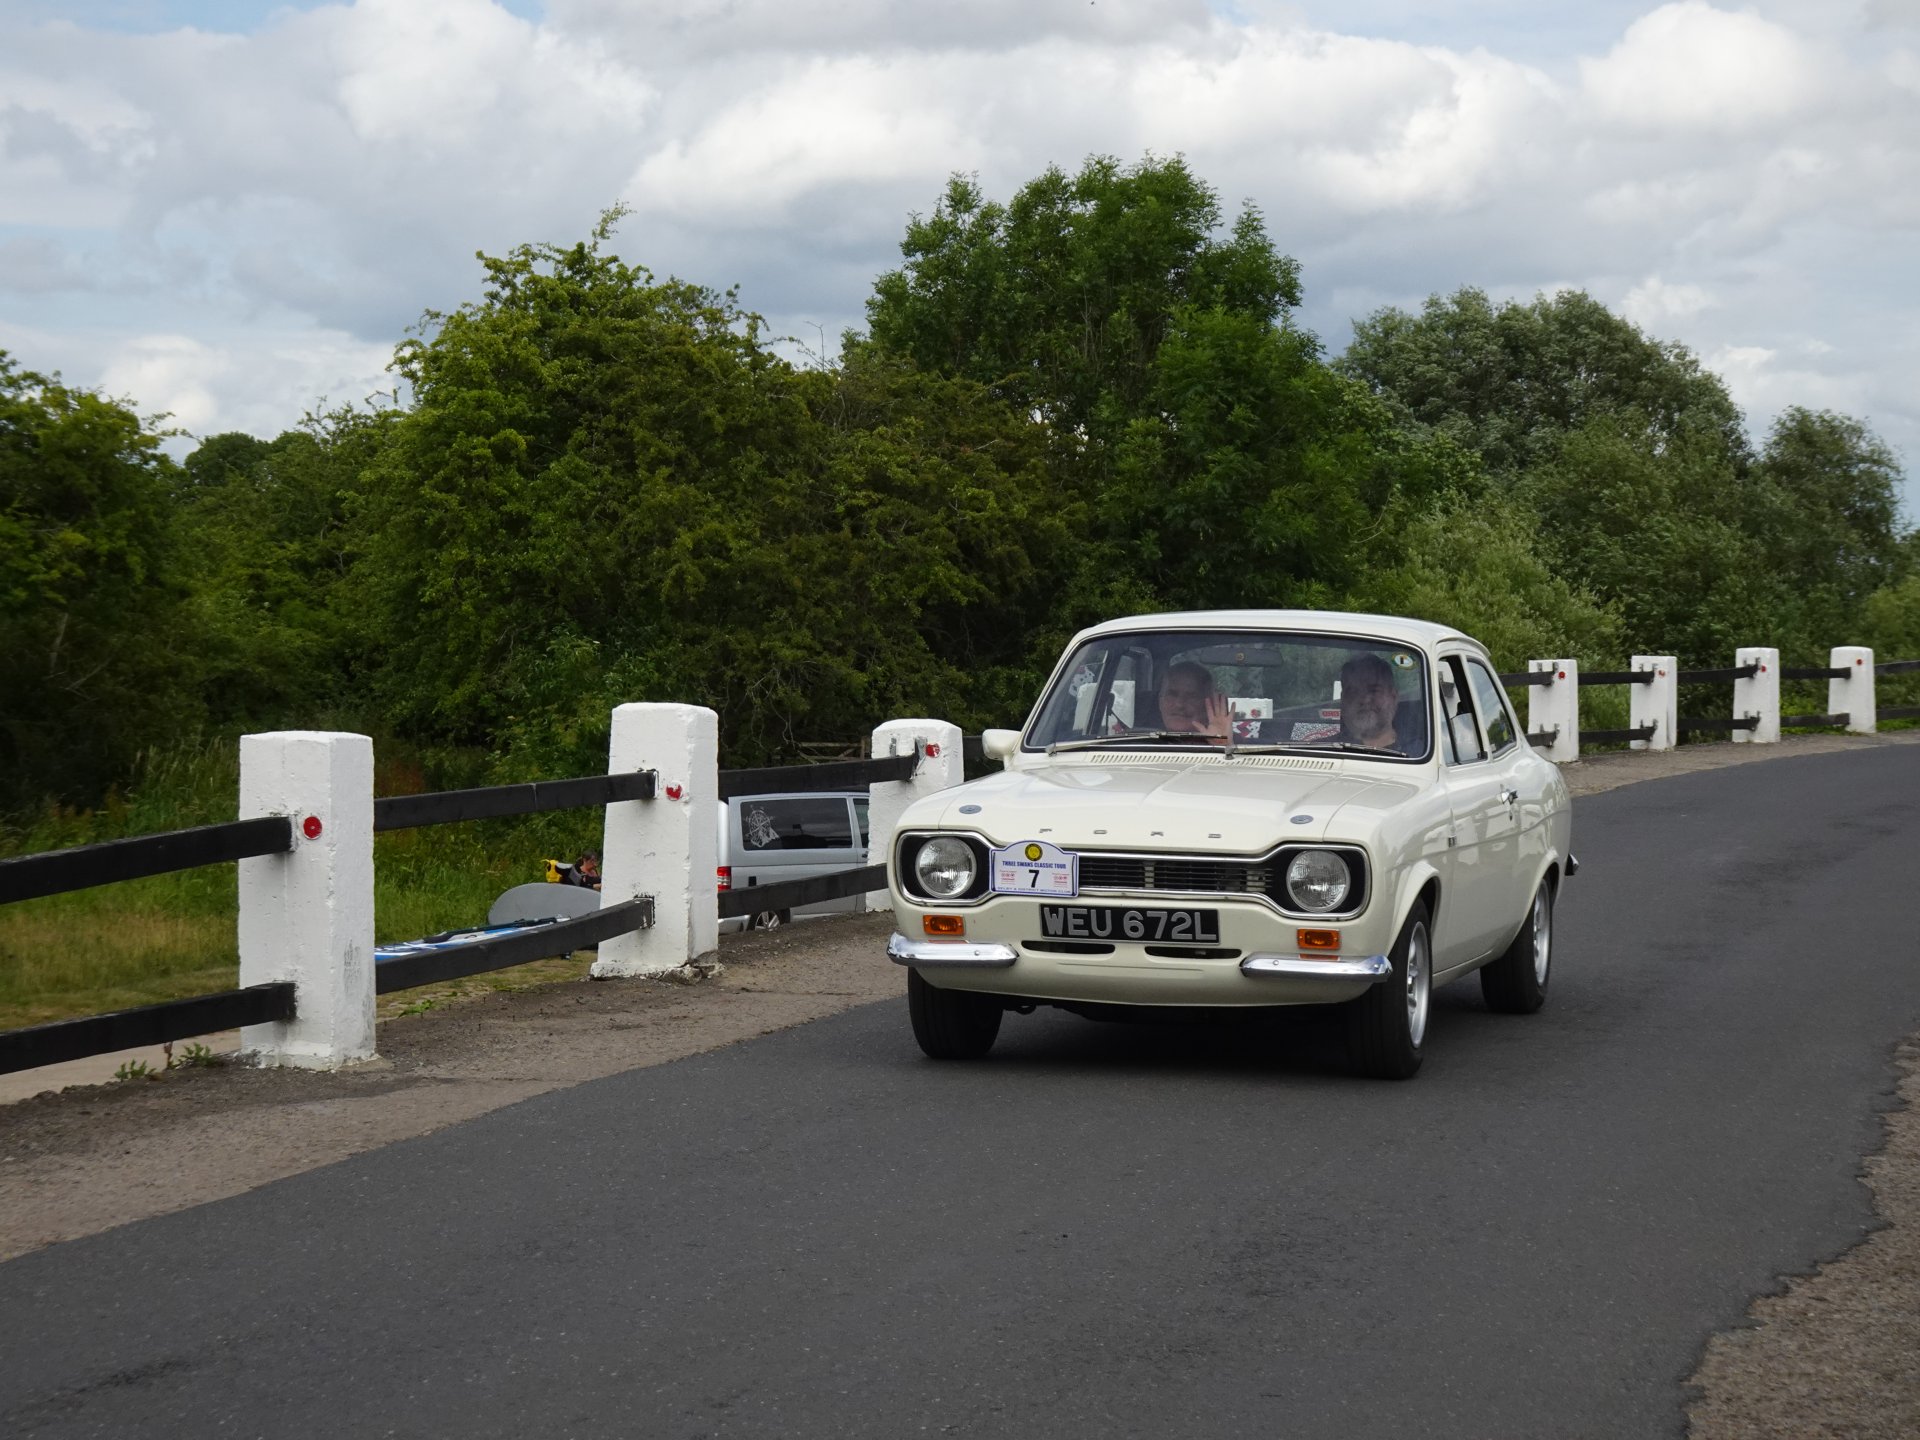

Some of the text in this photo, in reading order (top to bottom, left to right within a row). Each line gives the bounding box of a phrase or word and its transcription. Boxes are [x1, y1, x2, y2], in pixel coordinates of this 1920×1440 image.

[1029, 869, 1040, 888] 7
[1043, 907, 1217, 940] WEU 672L
